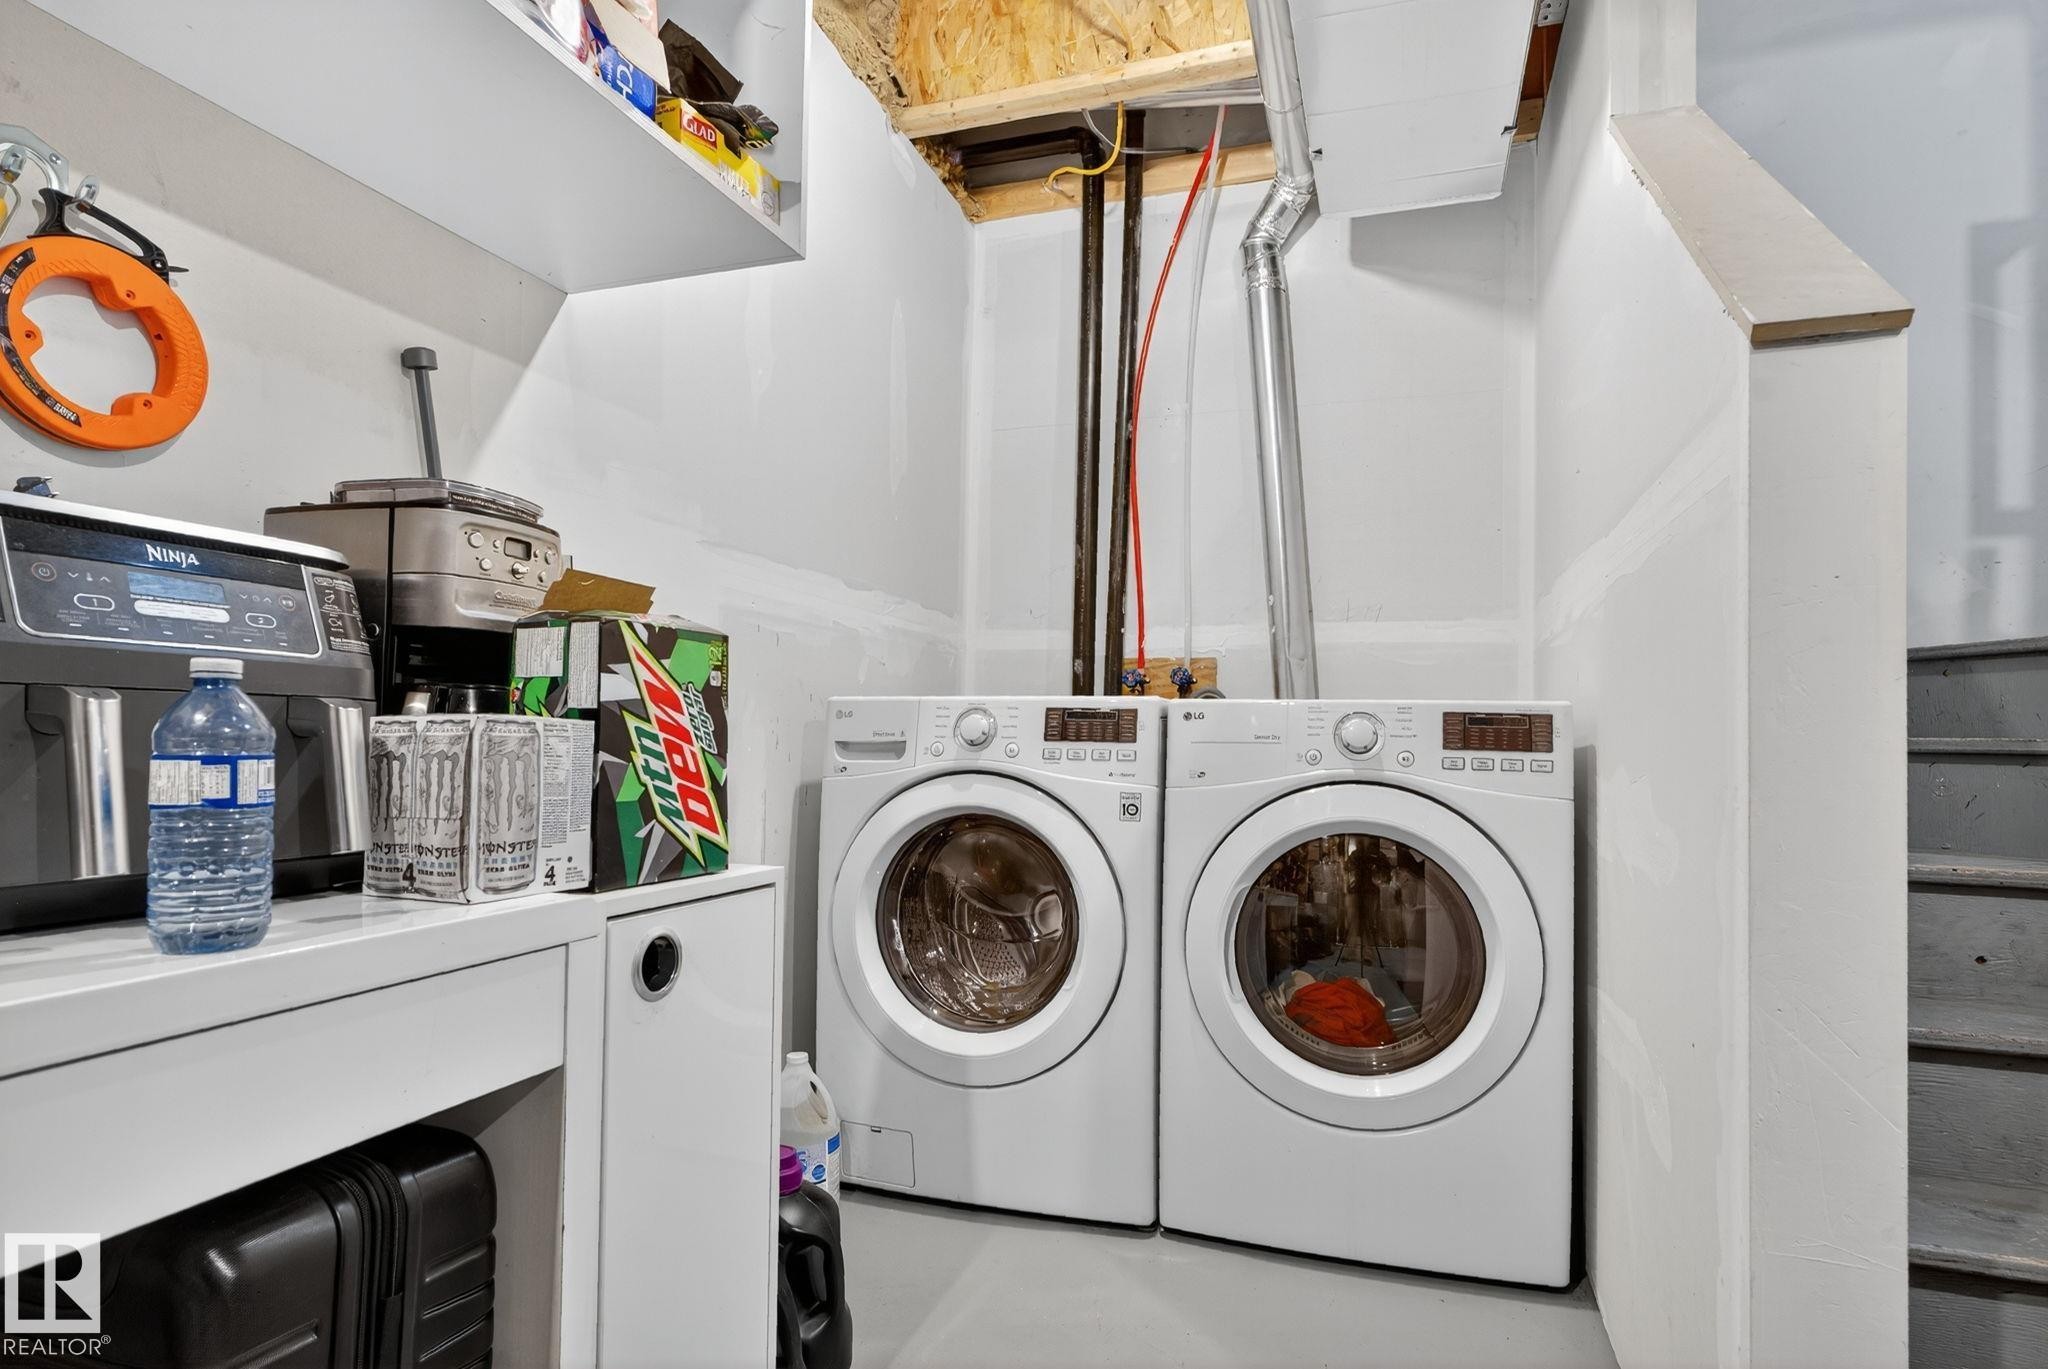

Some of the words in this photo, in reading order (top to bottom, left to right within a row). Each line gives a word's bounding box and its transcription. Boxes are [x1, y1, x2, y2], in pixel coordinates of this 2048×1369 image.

[683, 114, 716, 142] GLAD
[145, 543, 200, 568] NINJA
[1193, 712, 1205, 720] LG
[1122, 803, 1139, 816] 10
[402, 862, 417, 887] 4
[544, 865, 556, 882] 4
